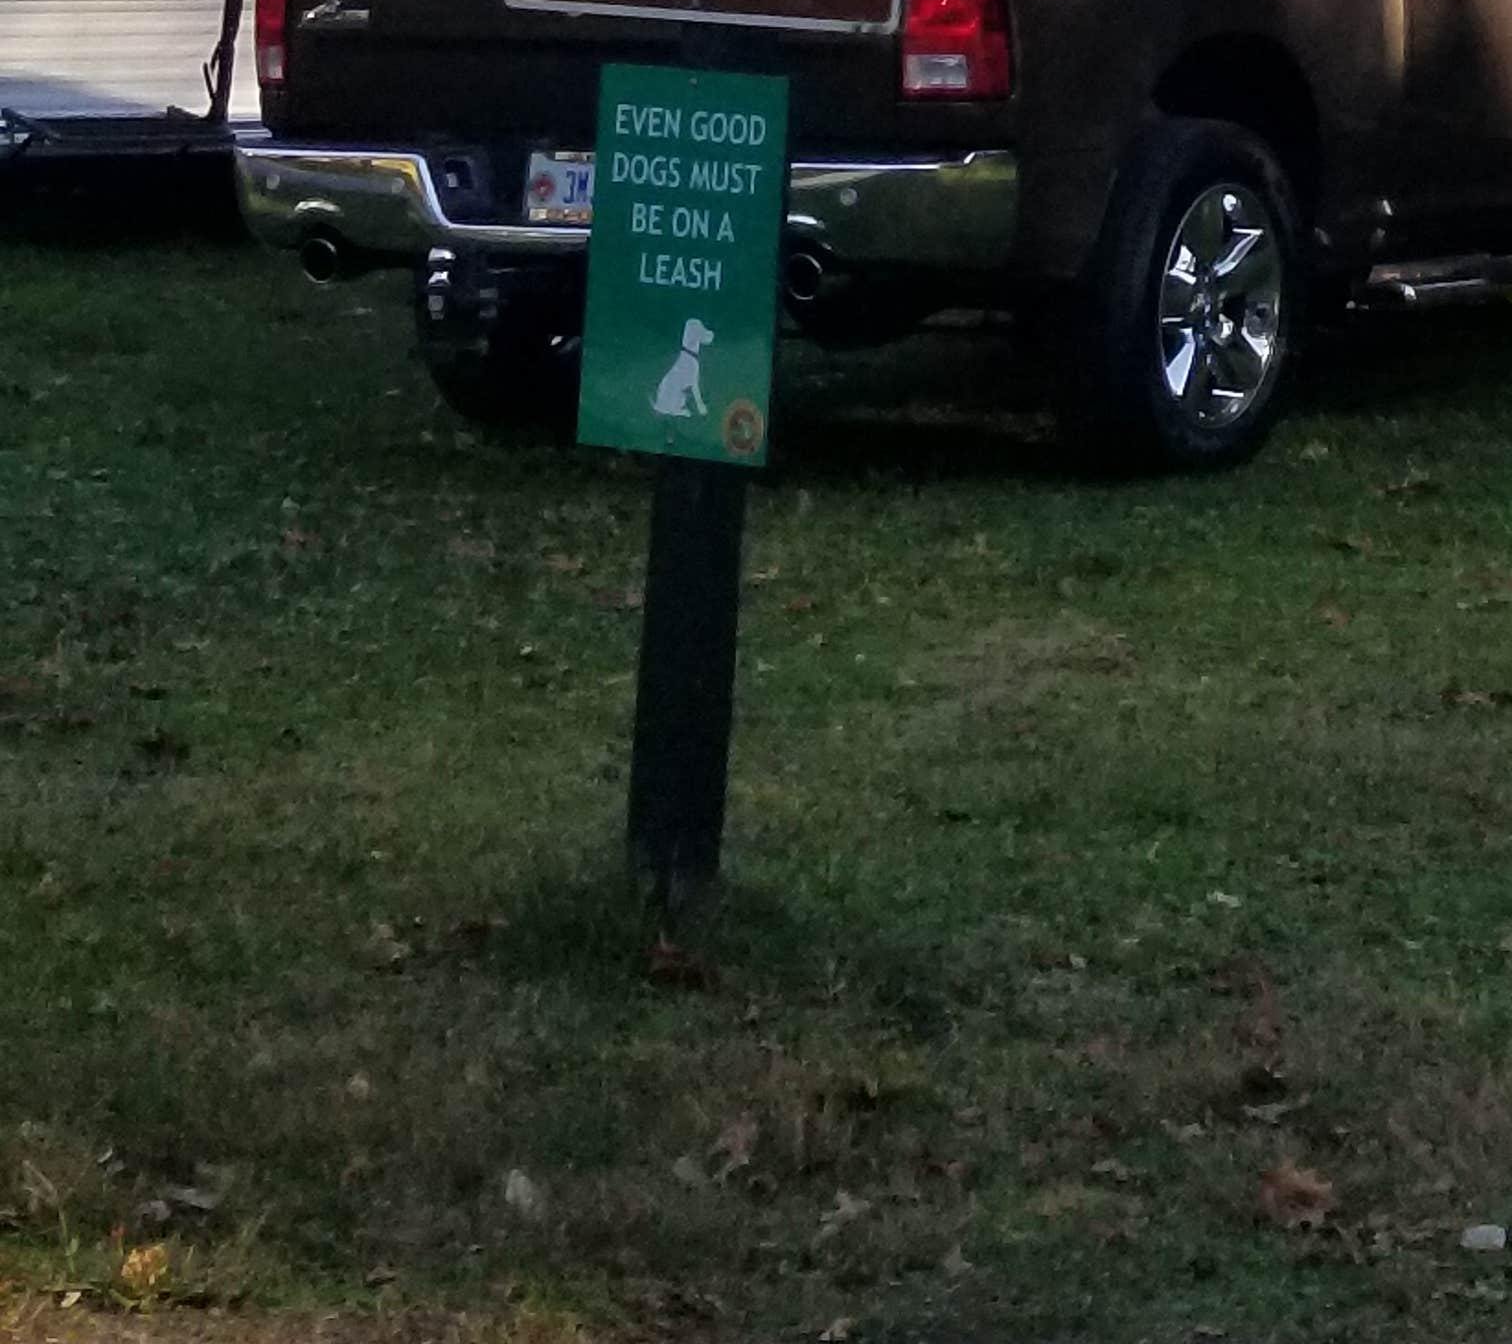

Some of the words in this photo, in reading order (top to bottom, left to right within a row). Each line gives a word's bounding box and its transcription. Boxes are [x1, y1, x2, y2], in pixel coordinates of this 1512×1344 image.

[615, 103, 682, 138] EVEN
[690, 111, 766, 146] GOOD
[612, 153, 681, 188] DOGS
[688, 162, 762, 195] MUST
[631, 203, 664, 236] BE
[671, 209, 709, 239] ON
[716, 212, 735, 243] A
[639, 253, 722, 291] LEASH
